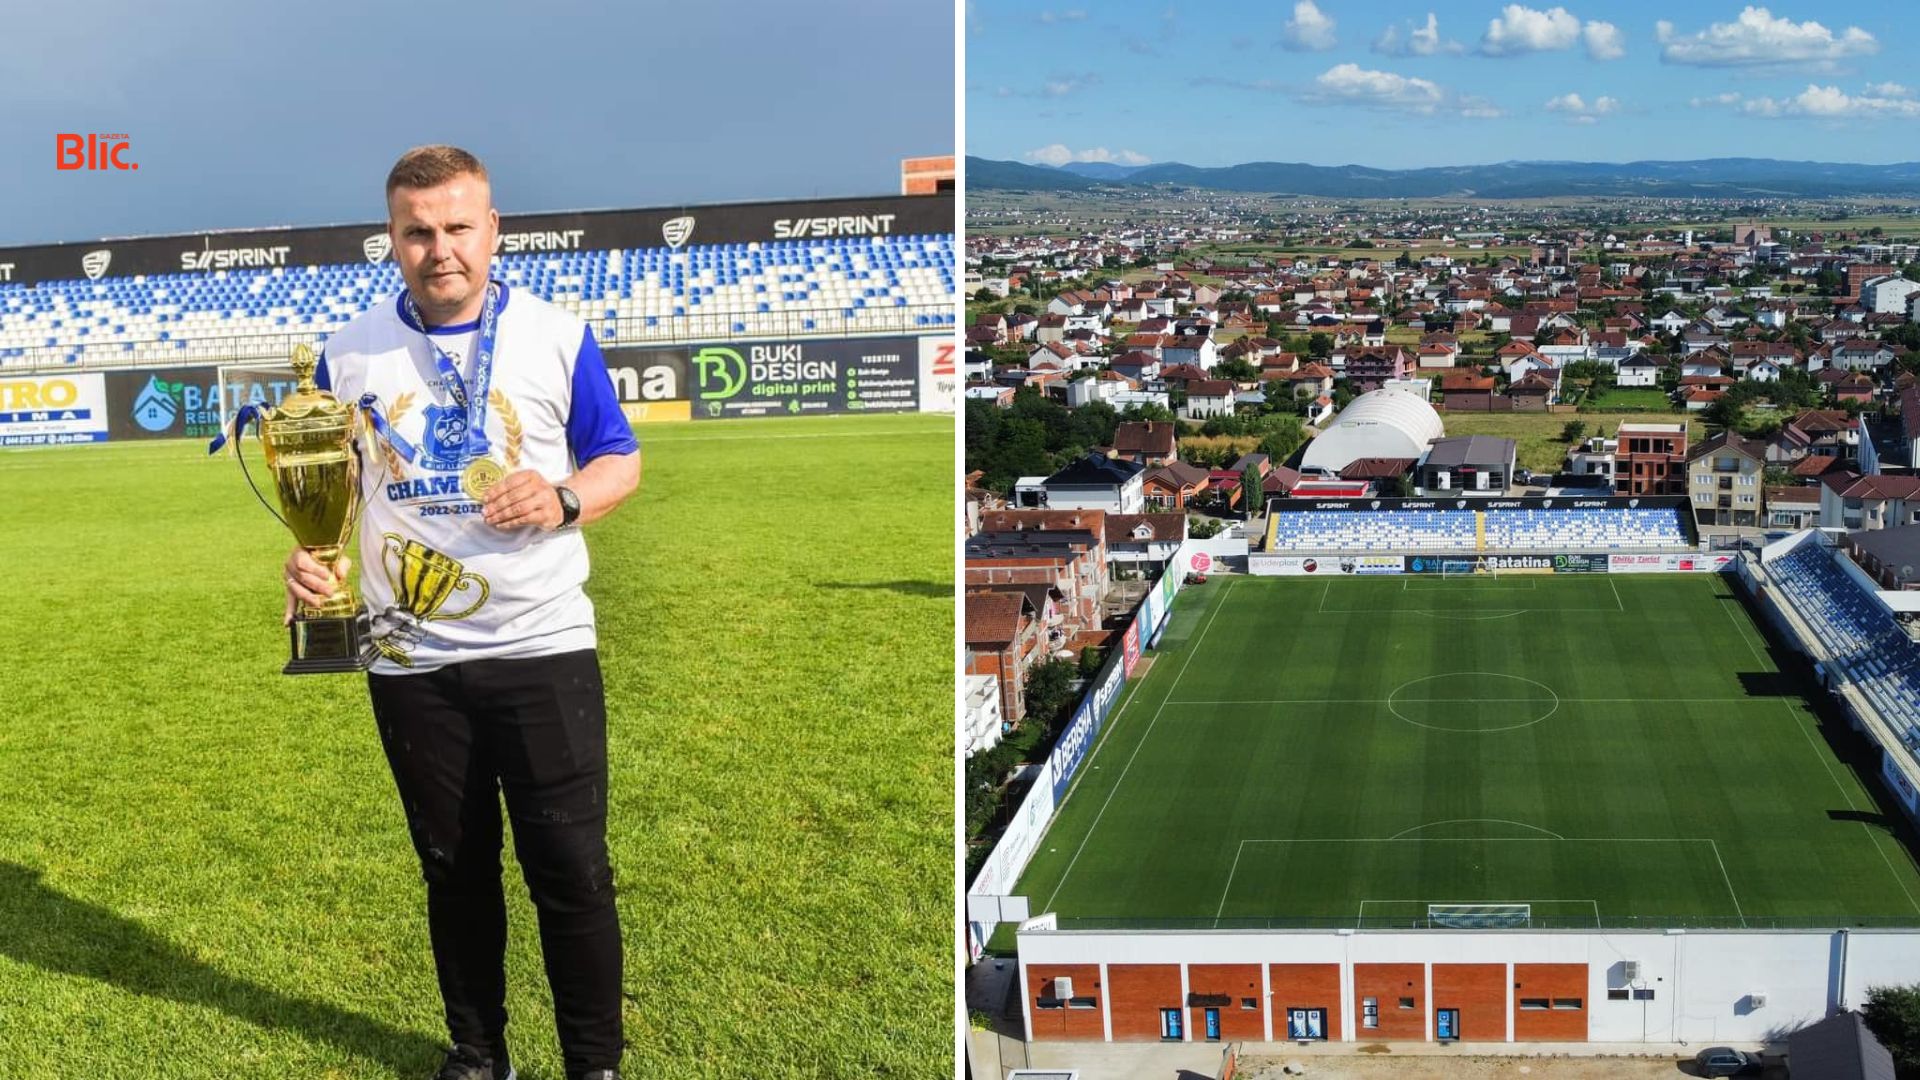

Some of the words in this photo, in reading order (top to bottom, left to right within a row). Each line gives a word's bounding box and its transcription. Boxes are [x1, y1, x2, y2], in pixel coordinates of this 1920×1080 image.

[751, 344, 802, 363] BUKI
[935, 345, 956, 364] Z
[751, 361, 837, 382] DESIGN
[607, 365, 677, 401] na
[751, 383, 797, 397] digital
[802, 381, 837, 396] print
[184, 381, 298, 411] BATATI
[12, 409, 77, 422] IMA
[387, 474, 461, 501] CHAM
[1487, 556, 1551, 569] Batatina
[1061, 703, 1092, 770] BERISHA
